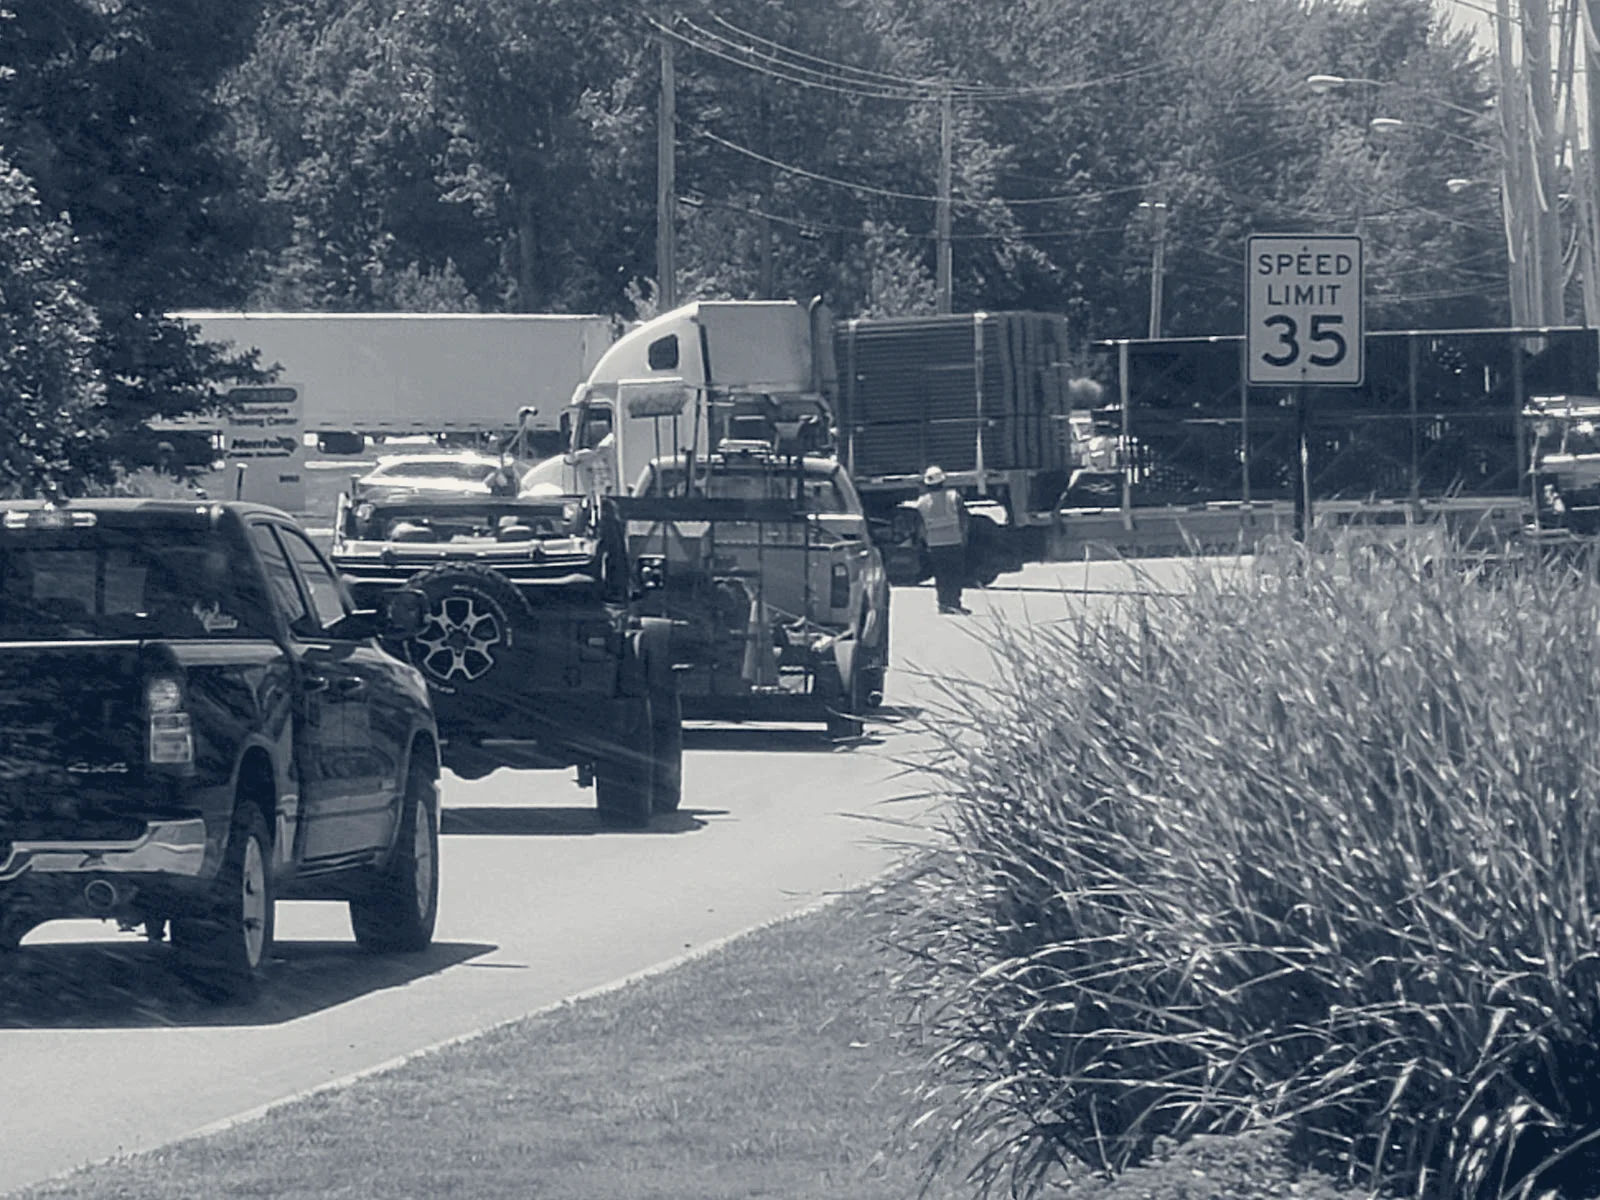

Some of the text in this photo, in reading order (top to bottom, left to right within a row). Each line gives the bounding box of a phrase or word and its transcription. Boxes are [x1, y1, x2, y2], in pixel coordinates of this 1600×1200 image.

[1258, 254, 1353, 275] SPEED
[1267, 284, 1342, 306] LIMIT
[1261, 314, 1348, 368] 35
